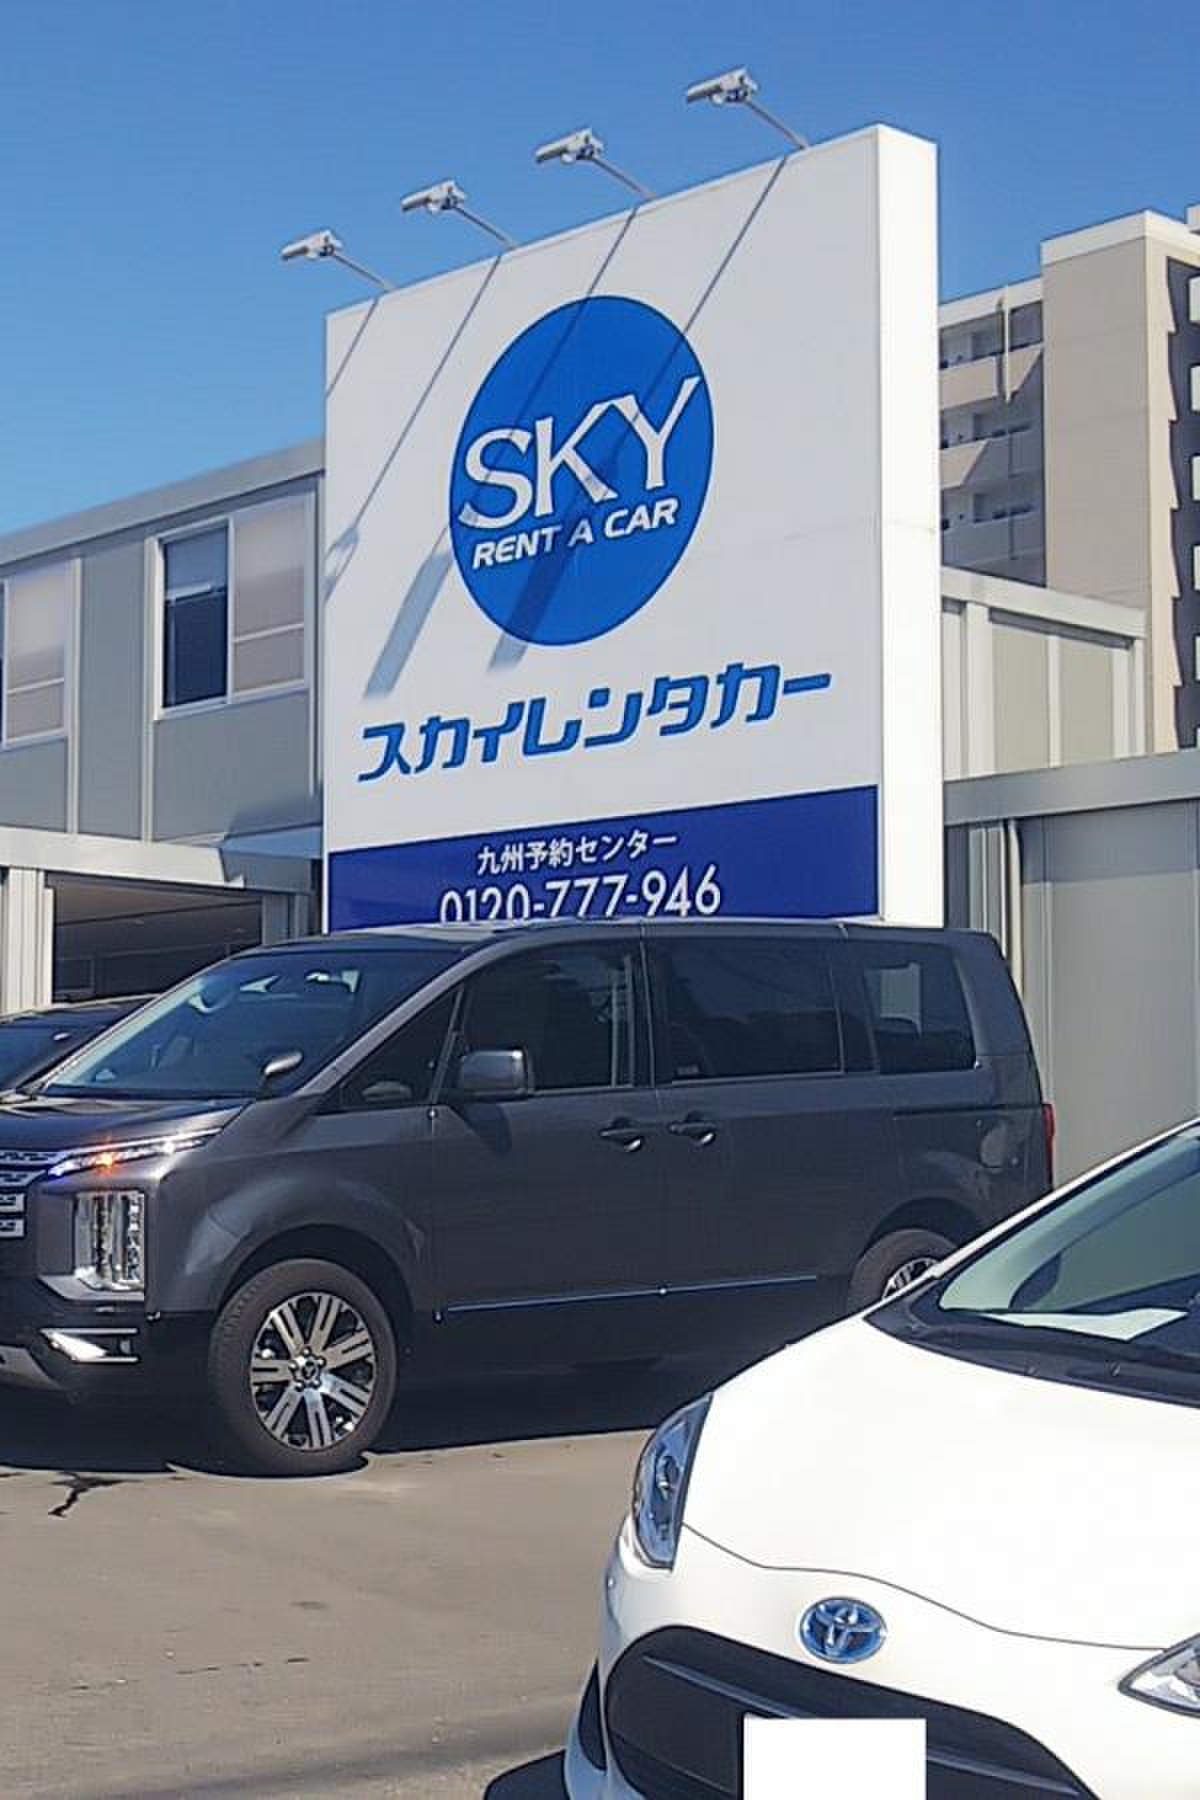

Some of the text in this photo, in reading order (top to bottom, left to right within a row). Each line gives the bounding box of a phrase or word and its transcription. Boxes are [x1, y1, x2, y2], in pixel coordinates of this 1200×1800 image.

[457, 375, 701, 529] SKY
[472, 497, 679, 570] RENT A CAR
[357, 661, 832, 783] スカイレンタカー
[476, 829, 678, 876] 九州予約センター
[439, 863, 721, 923] 0120-777-946
